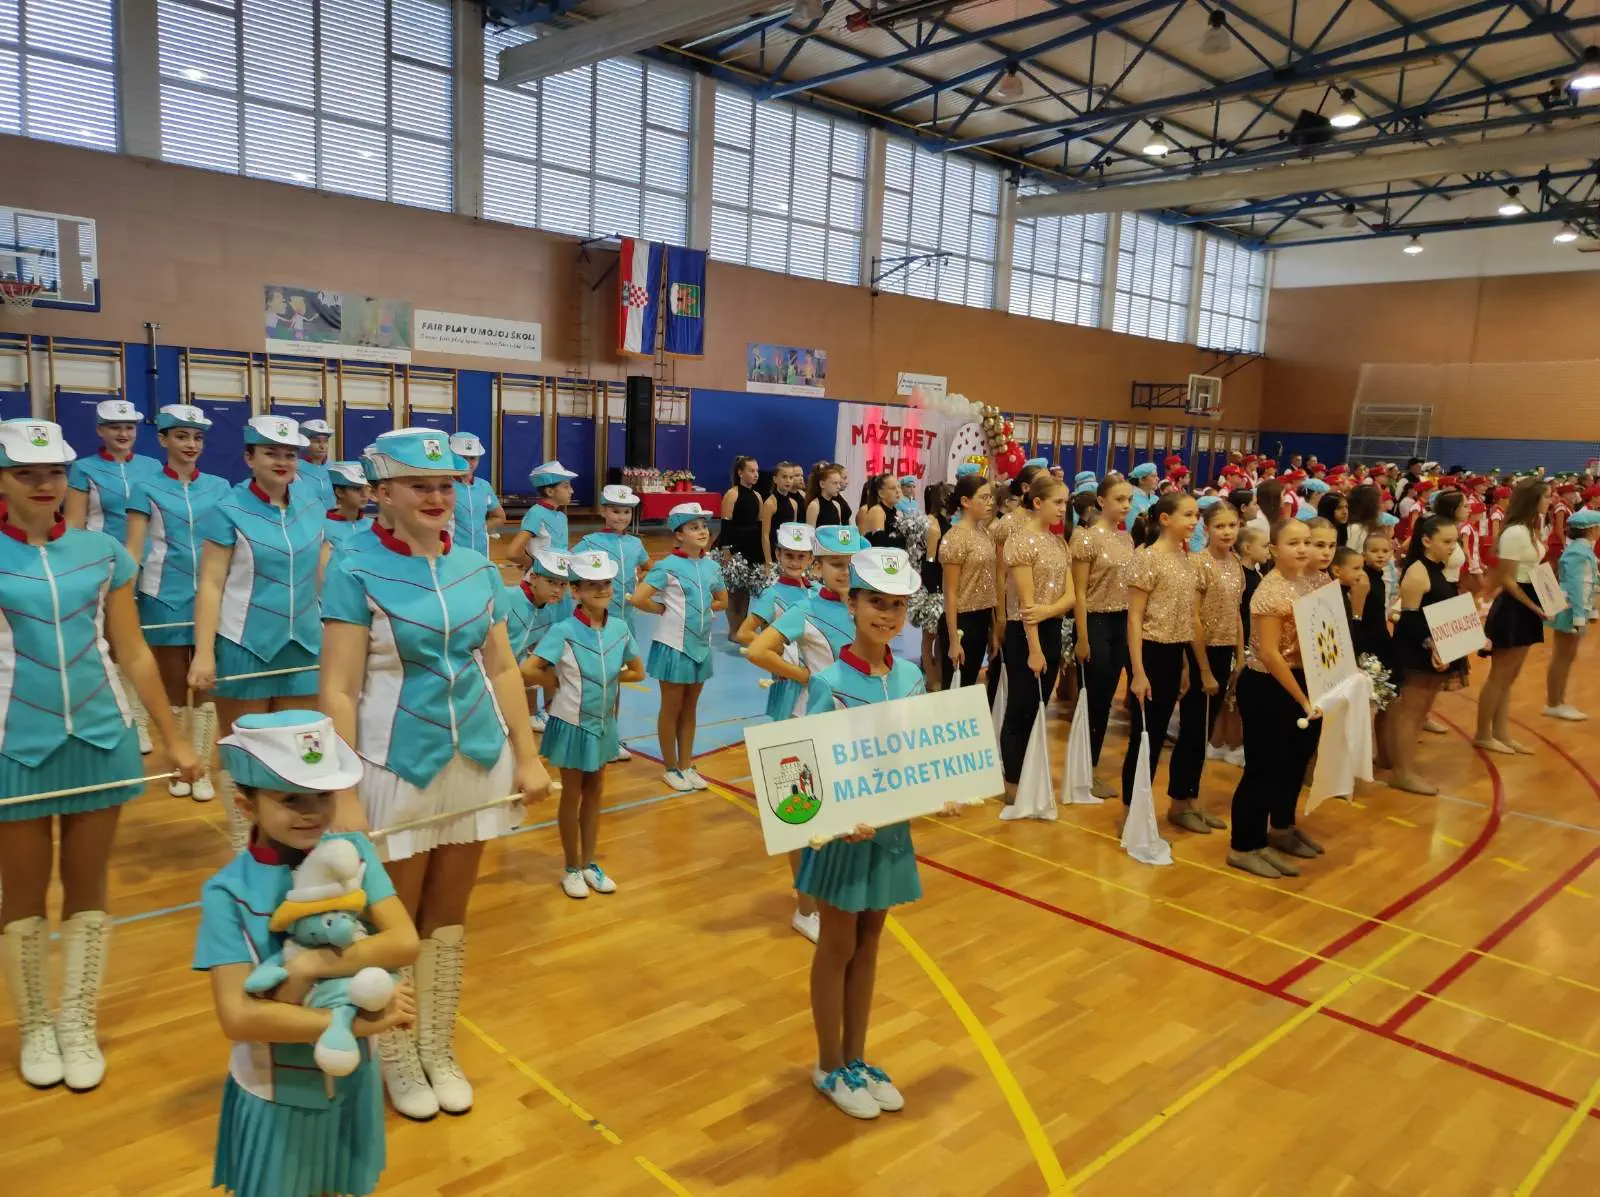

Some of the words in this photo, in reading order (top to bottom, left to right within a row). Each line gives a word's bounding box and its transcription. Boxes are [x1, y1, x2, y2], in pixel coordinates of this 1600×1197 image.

[421, 322, 443, 331] FAIR
[470, 327, 477, 335] U
[479, 328, 509, 339] MOJOJ
[510, 330, 535, 341] ŠKOLI
[851, 417, 938, 450] MAŽORET
[866, 456, 927, 480] SHOW
[831, 717, 981, 766] BJELOVARSKE
[832, 747, 995, 803] MAŽORETKINJE
